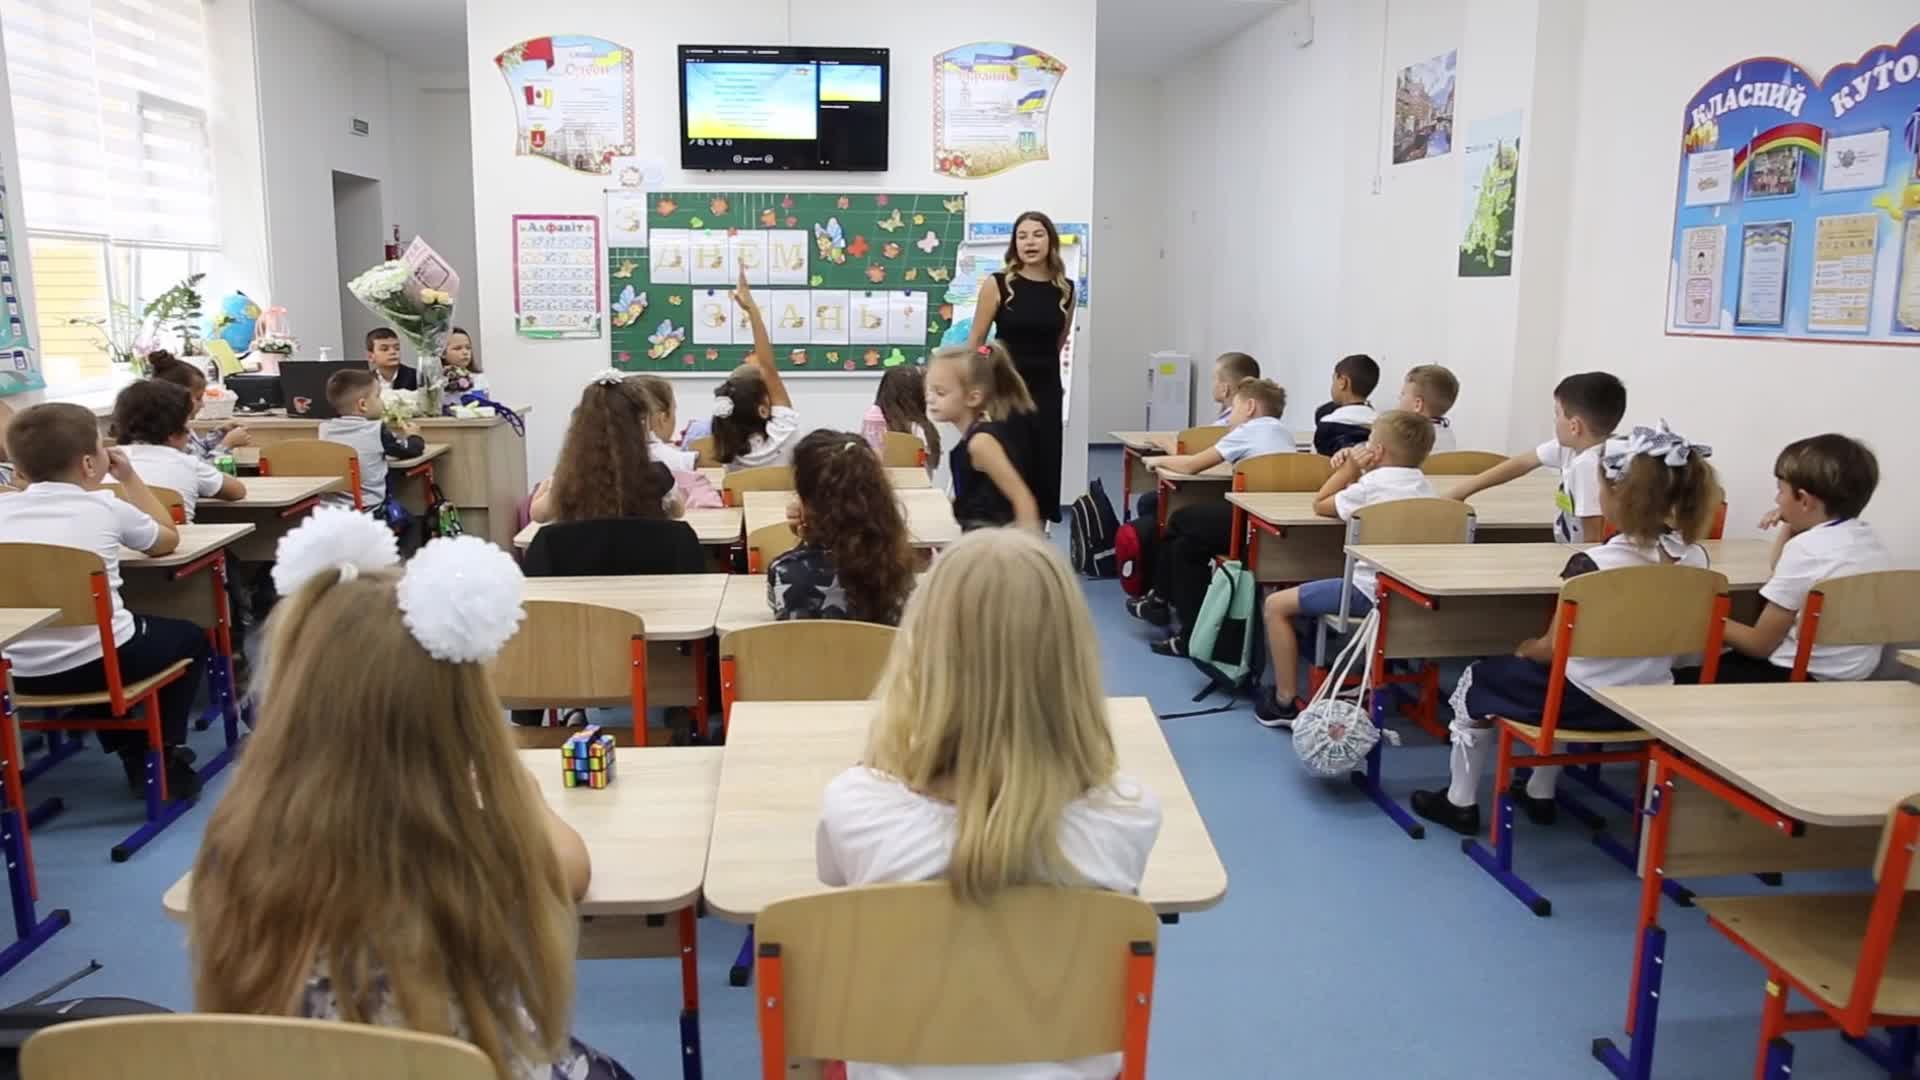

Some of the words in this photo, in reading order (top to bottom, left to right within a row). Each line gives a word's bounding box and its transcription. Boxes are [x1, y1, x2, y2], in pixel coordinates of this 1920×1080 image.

[1690, 81, 1807, 129] КЛАСНИЙ
[1830, 54, 1920, 119] КУТО
[655, 242, 805, 272] ДНЕМ
